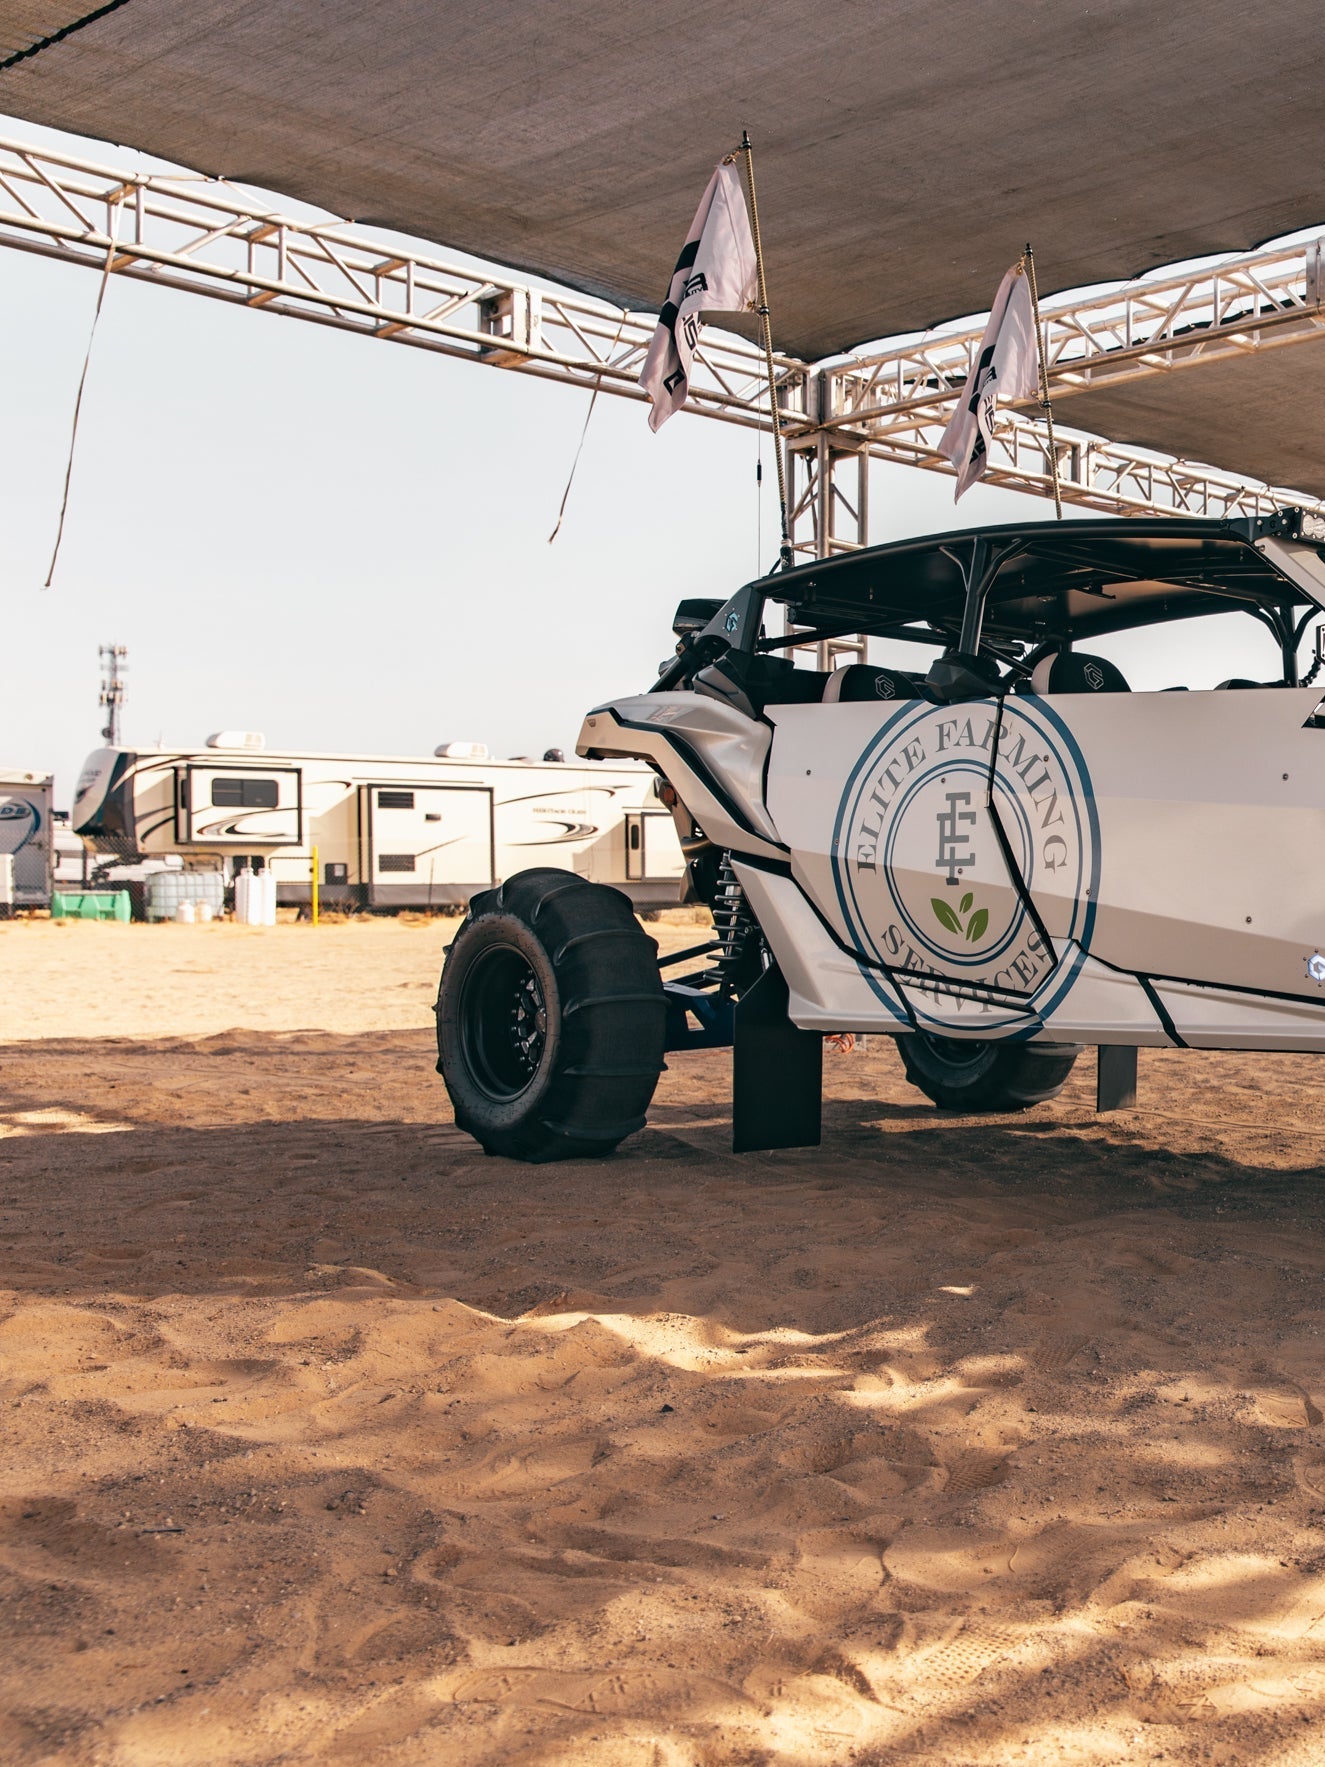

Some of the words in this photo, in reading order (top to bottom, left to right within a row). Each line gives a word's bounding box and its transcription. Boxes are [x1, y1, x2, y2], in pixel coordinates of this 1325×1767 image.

[857, 737, 926, 875] ELITE
[935, 717, 1068, 874] FARMING
[881, 924, 1051, 1014] SERVICES
